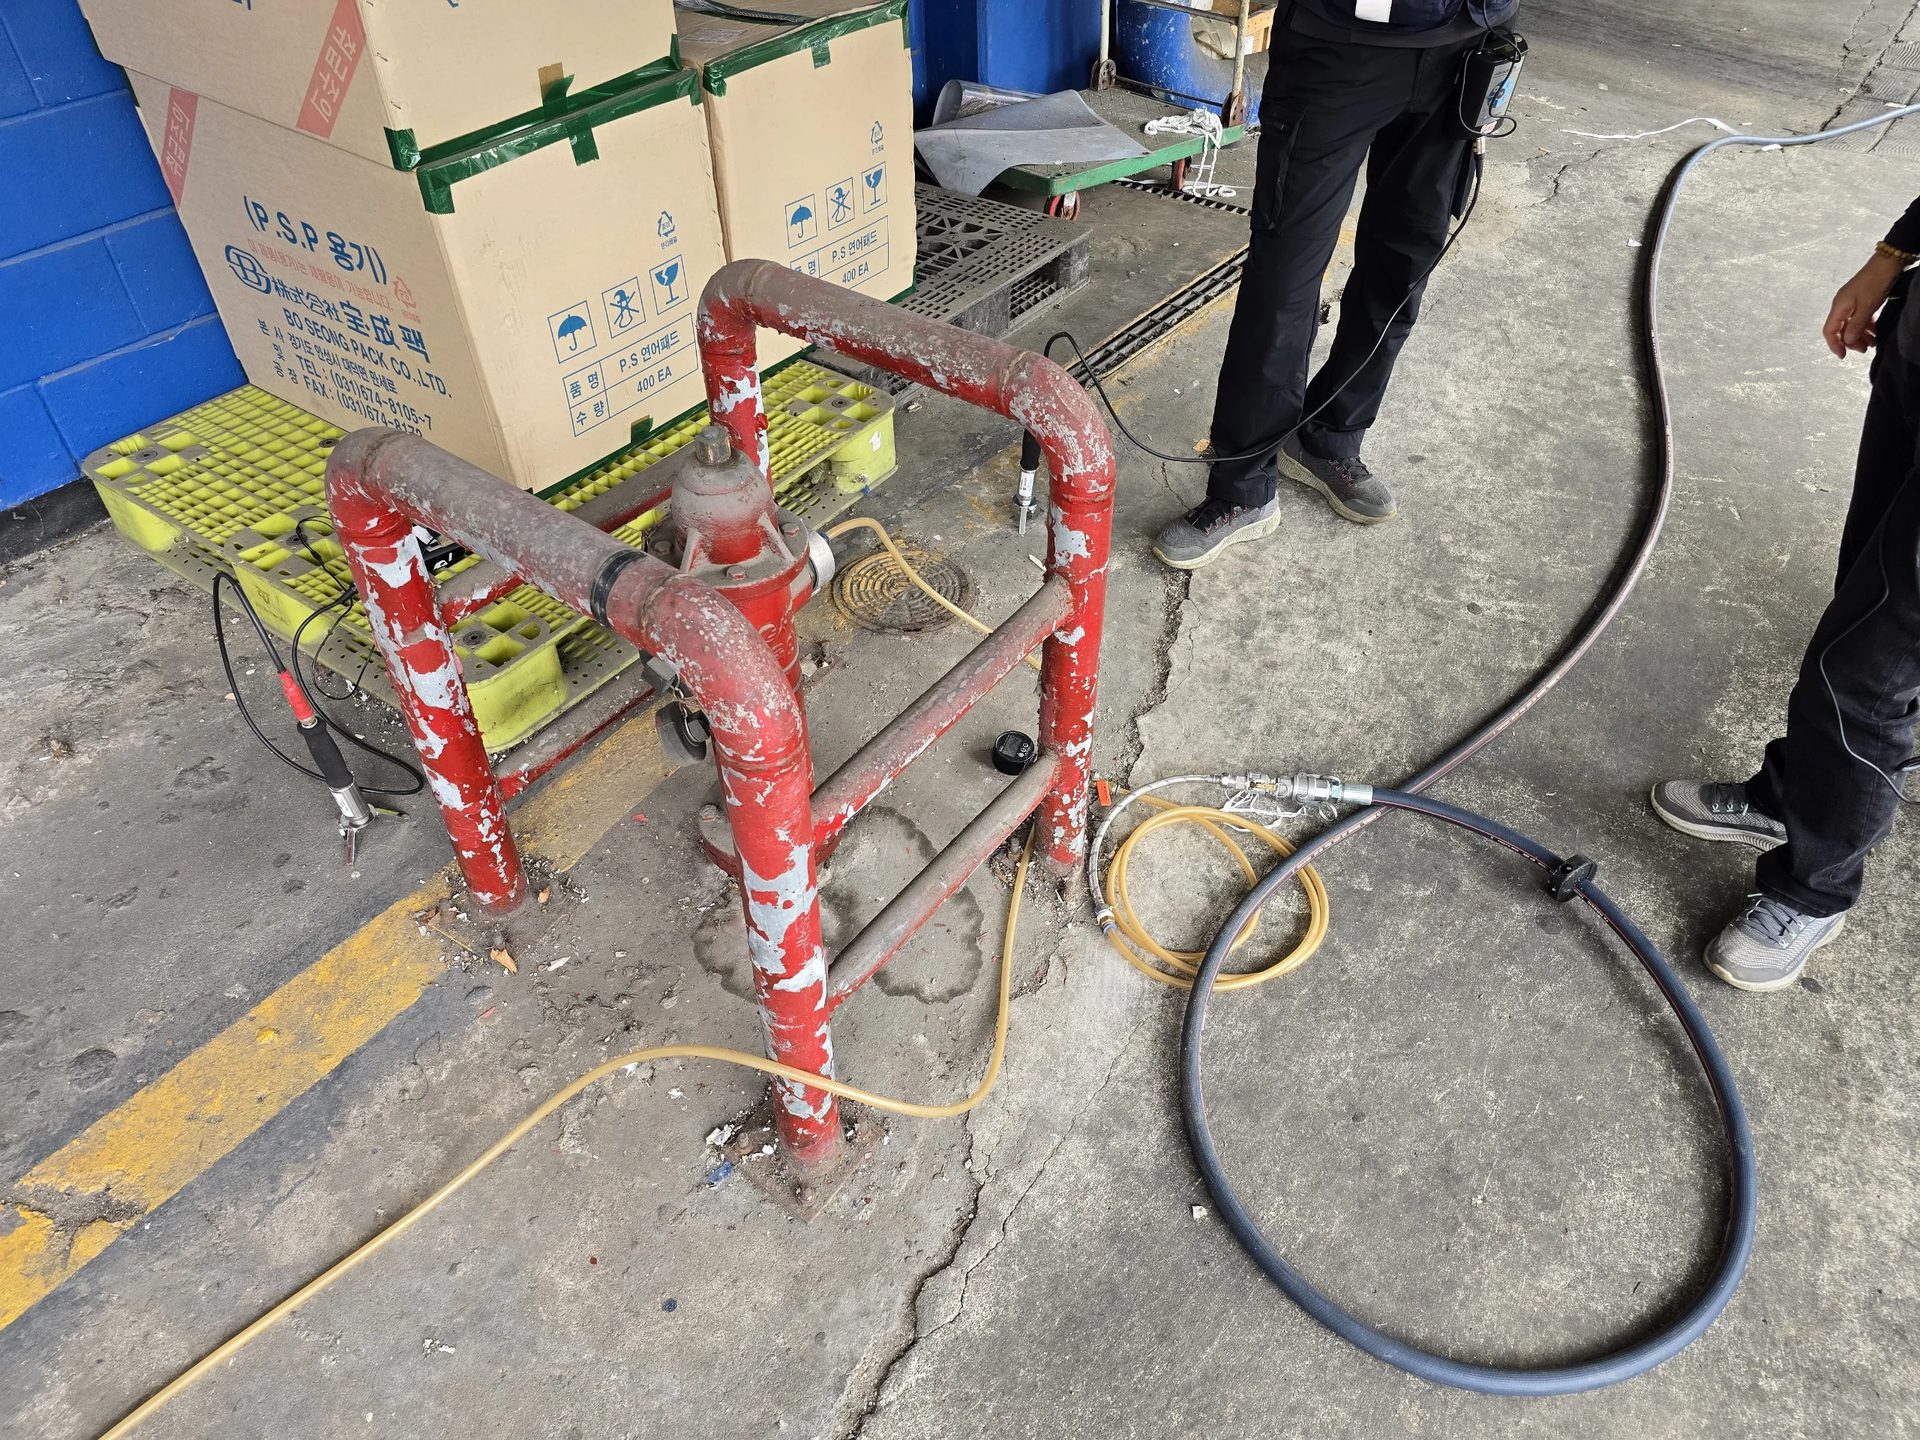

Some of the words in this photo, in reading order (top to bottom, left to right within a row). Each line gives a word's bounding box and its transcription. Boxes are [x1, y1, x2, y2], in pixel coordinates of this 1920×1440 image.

[310, 25, 357, 124] 취급주의
[165, 100, 191, 177] 취급주의
[243, 195, 318, 252] (P.S.P
[326, 231, 387, 285] 용기)
[832, 246, 846, 263] P.S
[848, 230, 878, 256] 연어패드
[842, 268, 857, 284] 400
[858, 261, 869, 277] EA
[283, 308, 304, 331] BO
[304, 317, 351, 352] SEONG
[350, 338, 390, 370] PACK
[287, 332, 315, 356] 경기도
[314, 344, 342, 370] 안성시
[619, 352, 639, 373] P.S
[640, 330, 681, 363] 연어패드
[637, 374, 655, 393] 400
[657, 366, 672, 383] EA
